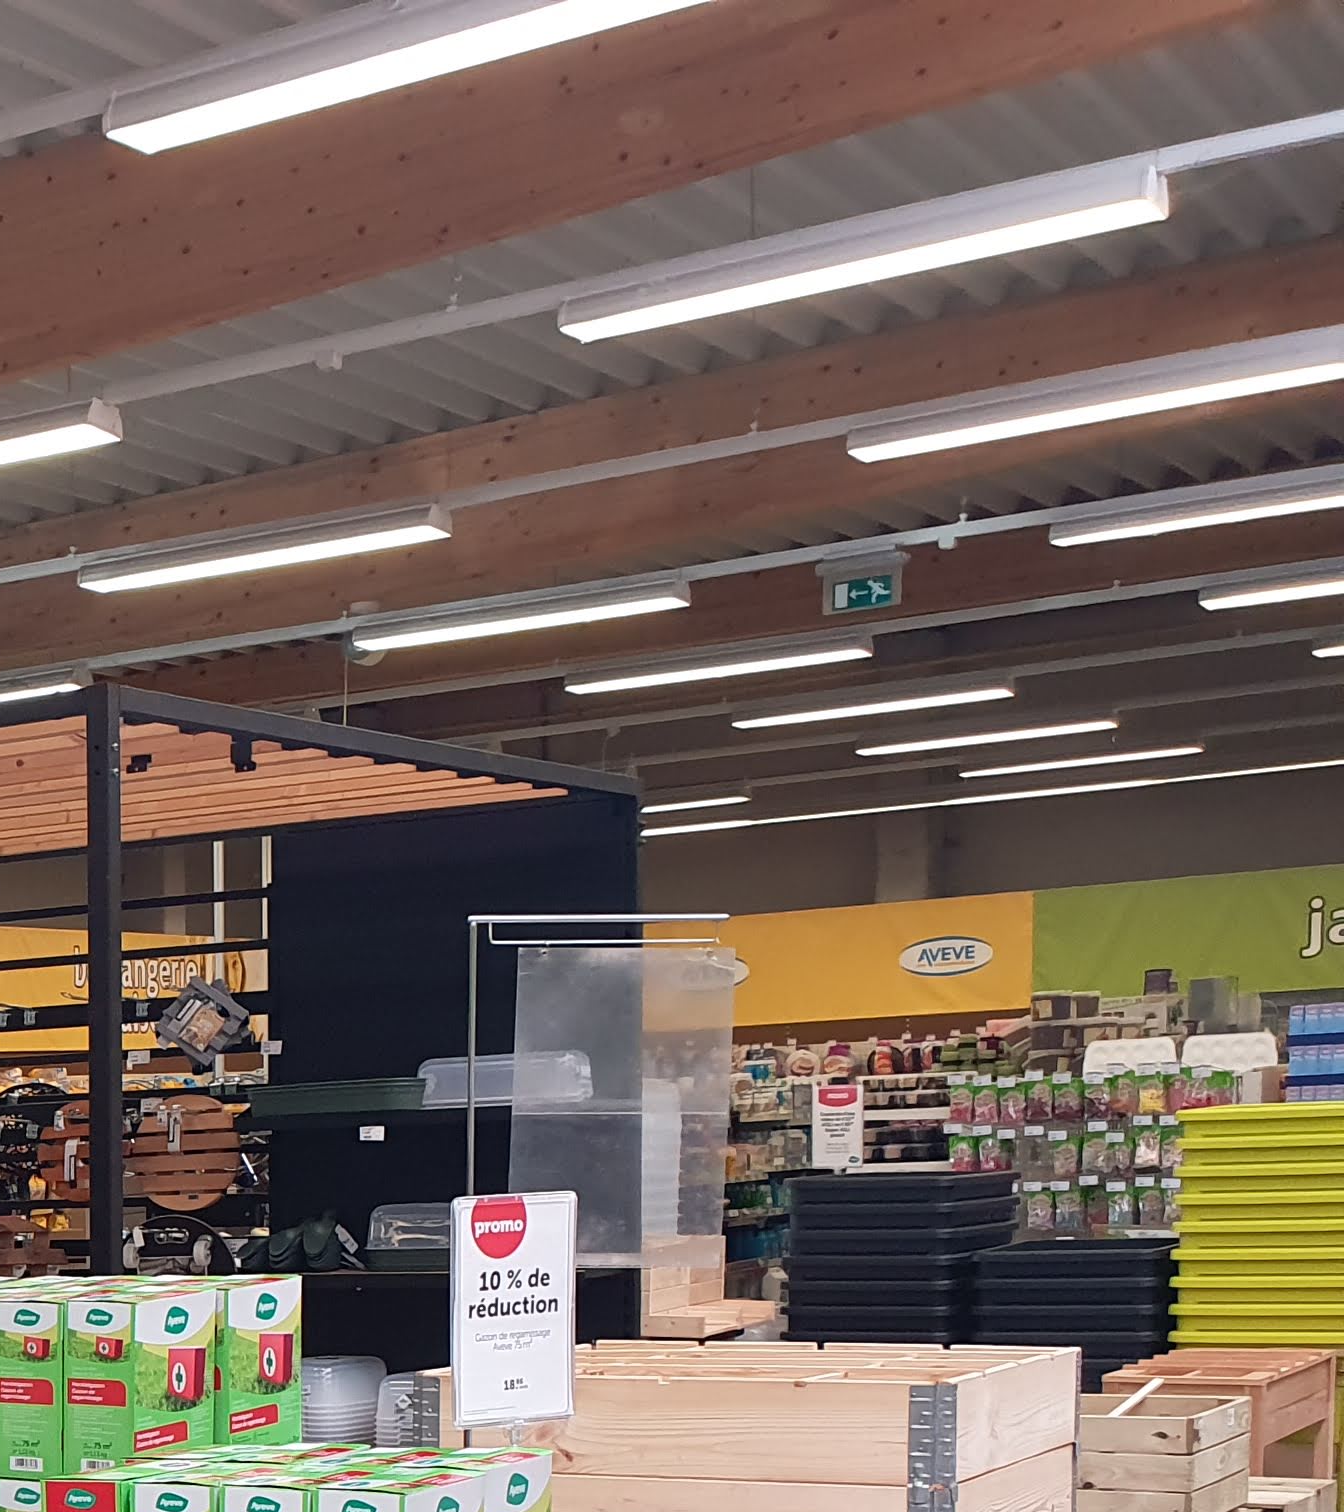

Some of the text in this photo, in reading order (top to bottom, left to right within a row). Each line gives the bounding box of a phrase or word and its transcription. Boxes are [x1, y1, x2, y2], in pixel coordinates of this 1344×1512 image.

[916, 943, 976, 966] AVEVE
[474, 1218, 525, 1238] promo
[479, 1268, 551, 1291] 10 % de
[468, 1295, 559, 1319] réduction
